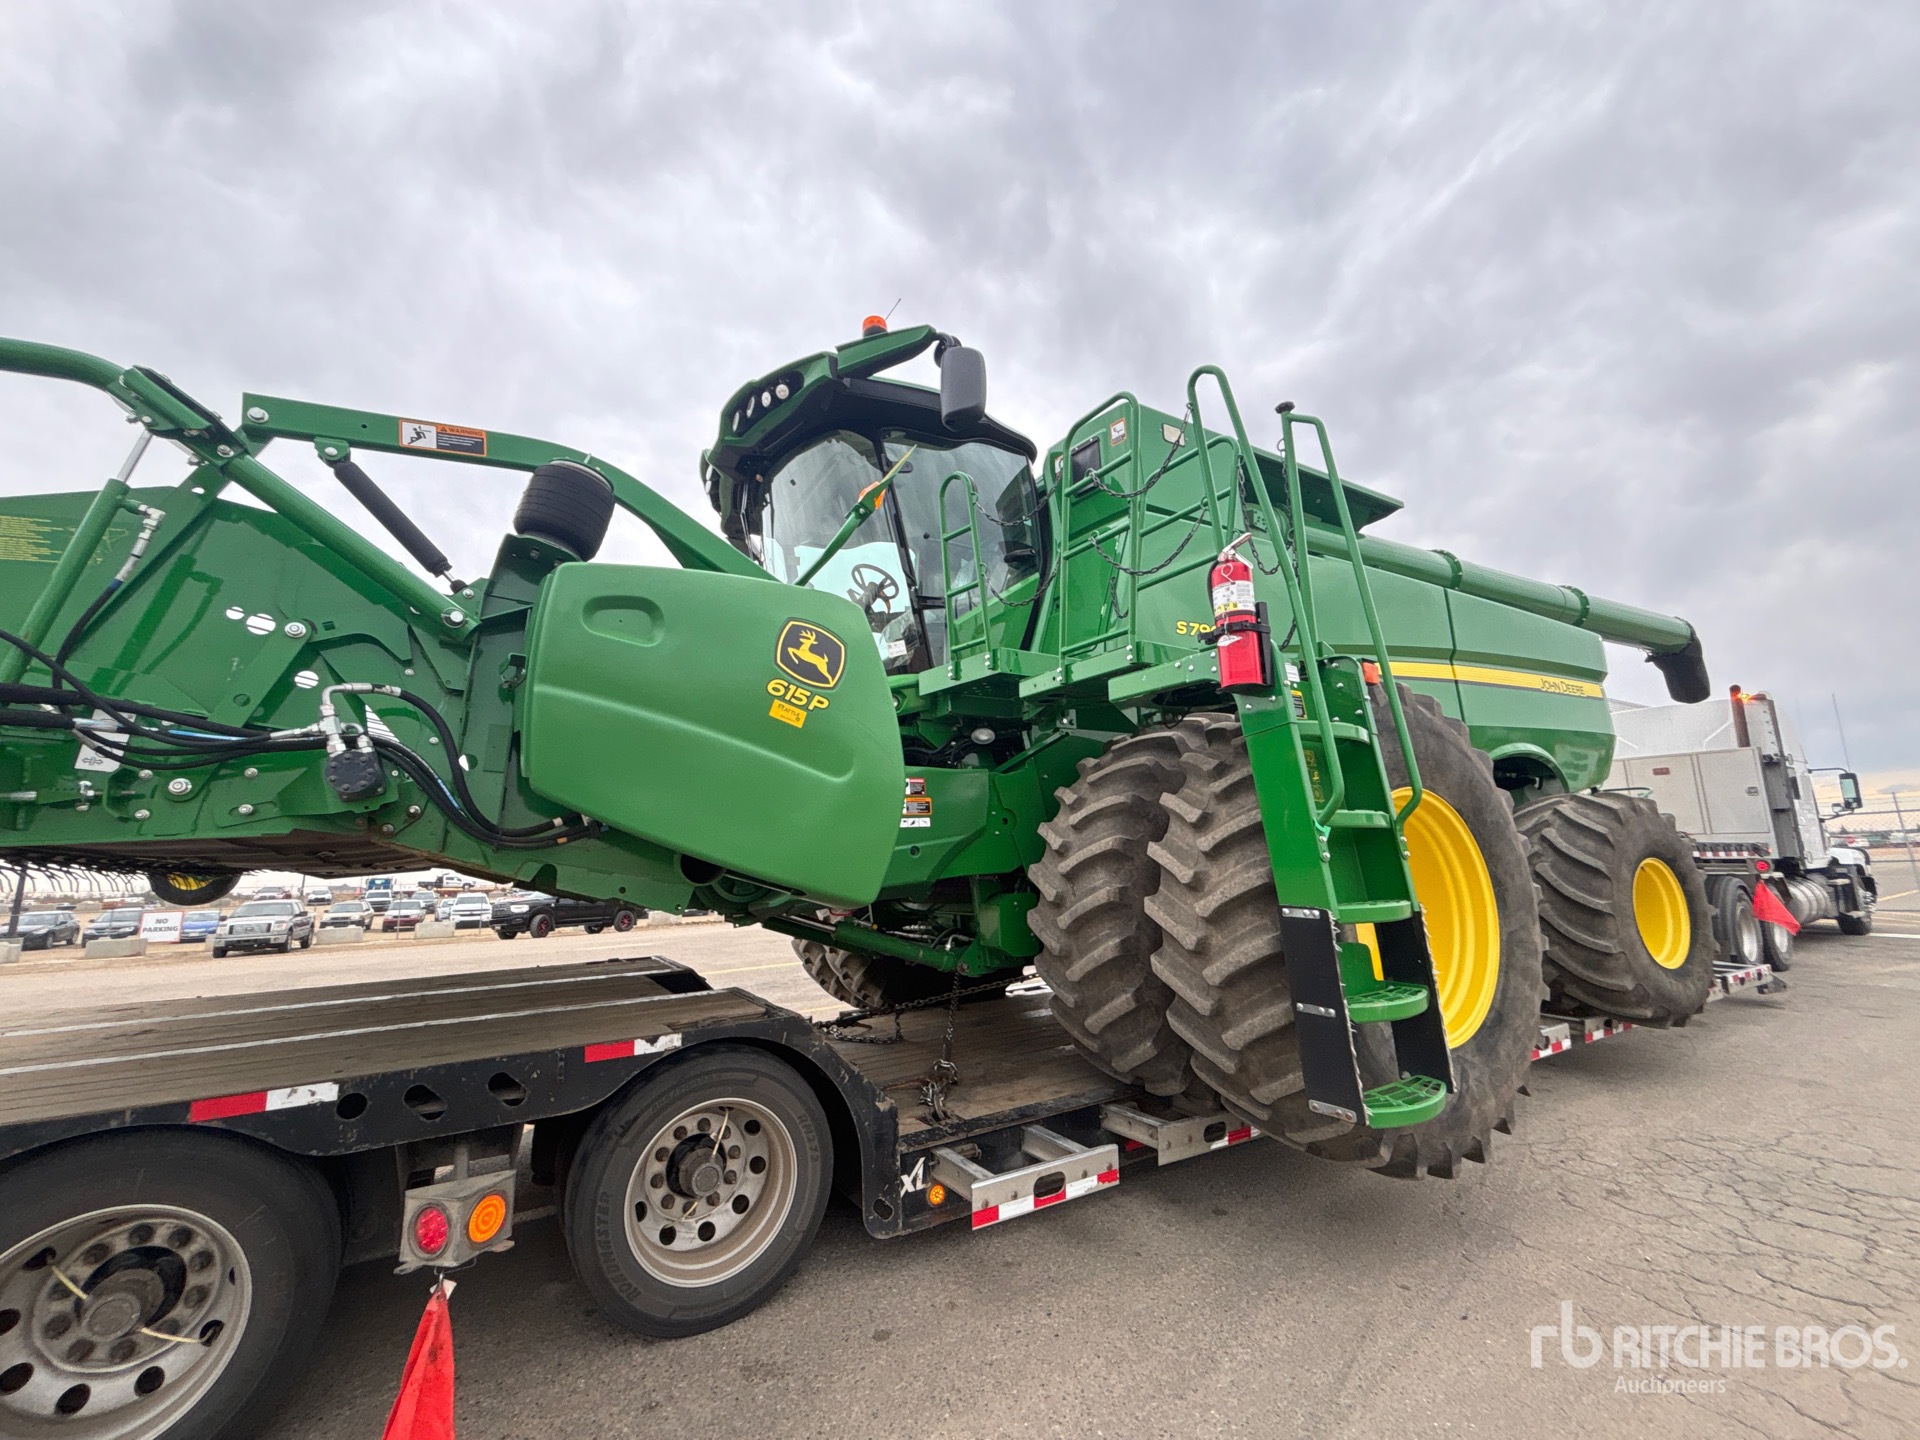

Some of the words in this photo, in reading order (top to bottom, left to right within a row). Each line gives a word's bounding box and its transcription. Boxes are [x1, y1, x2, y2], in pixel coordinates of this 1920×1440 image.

[449, 427, 483, 436] WARNING
[1176, 621, 1217, 636] S79
[1540, 677, 1561, 691] JOHN
[1560, 680, 1586, 695] DEERE
[766, 679, 830, 711] 615P
